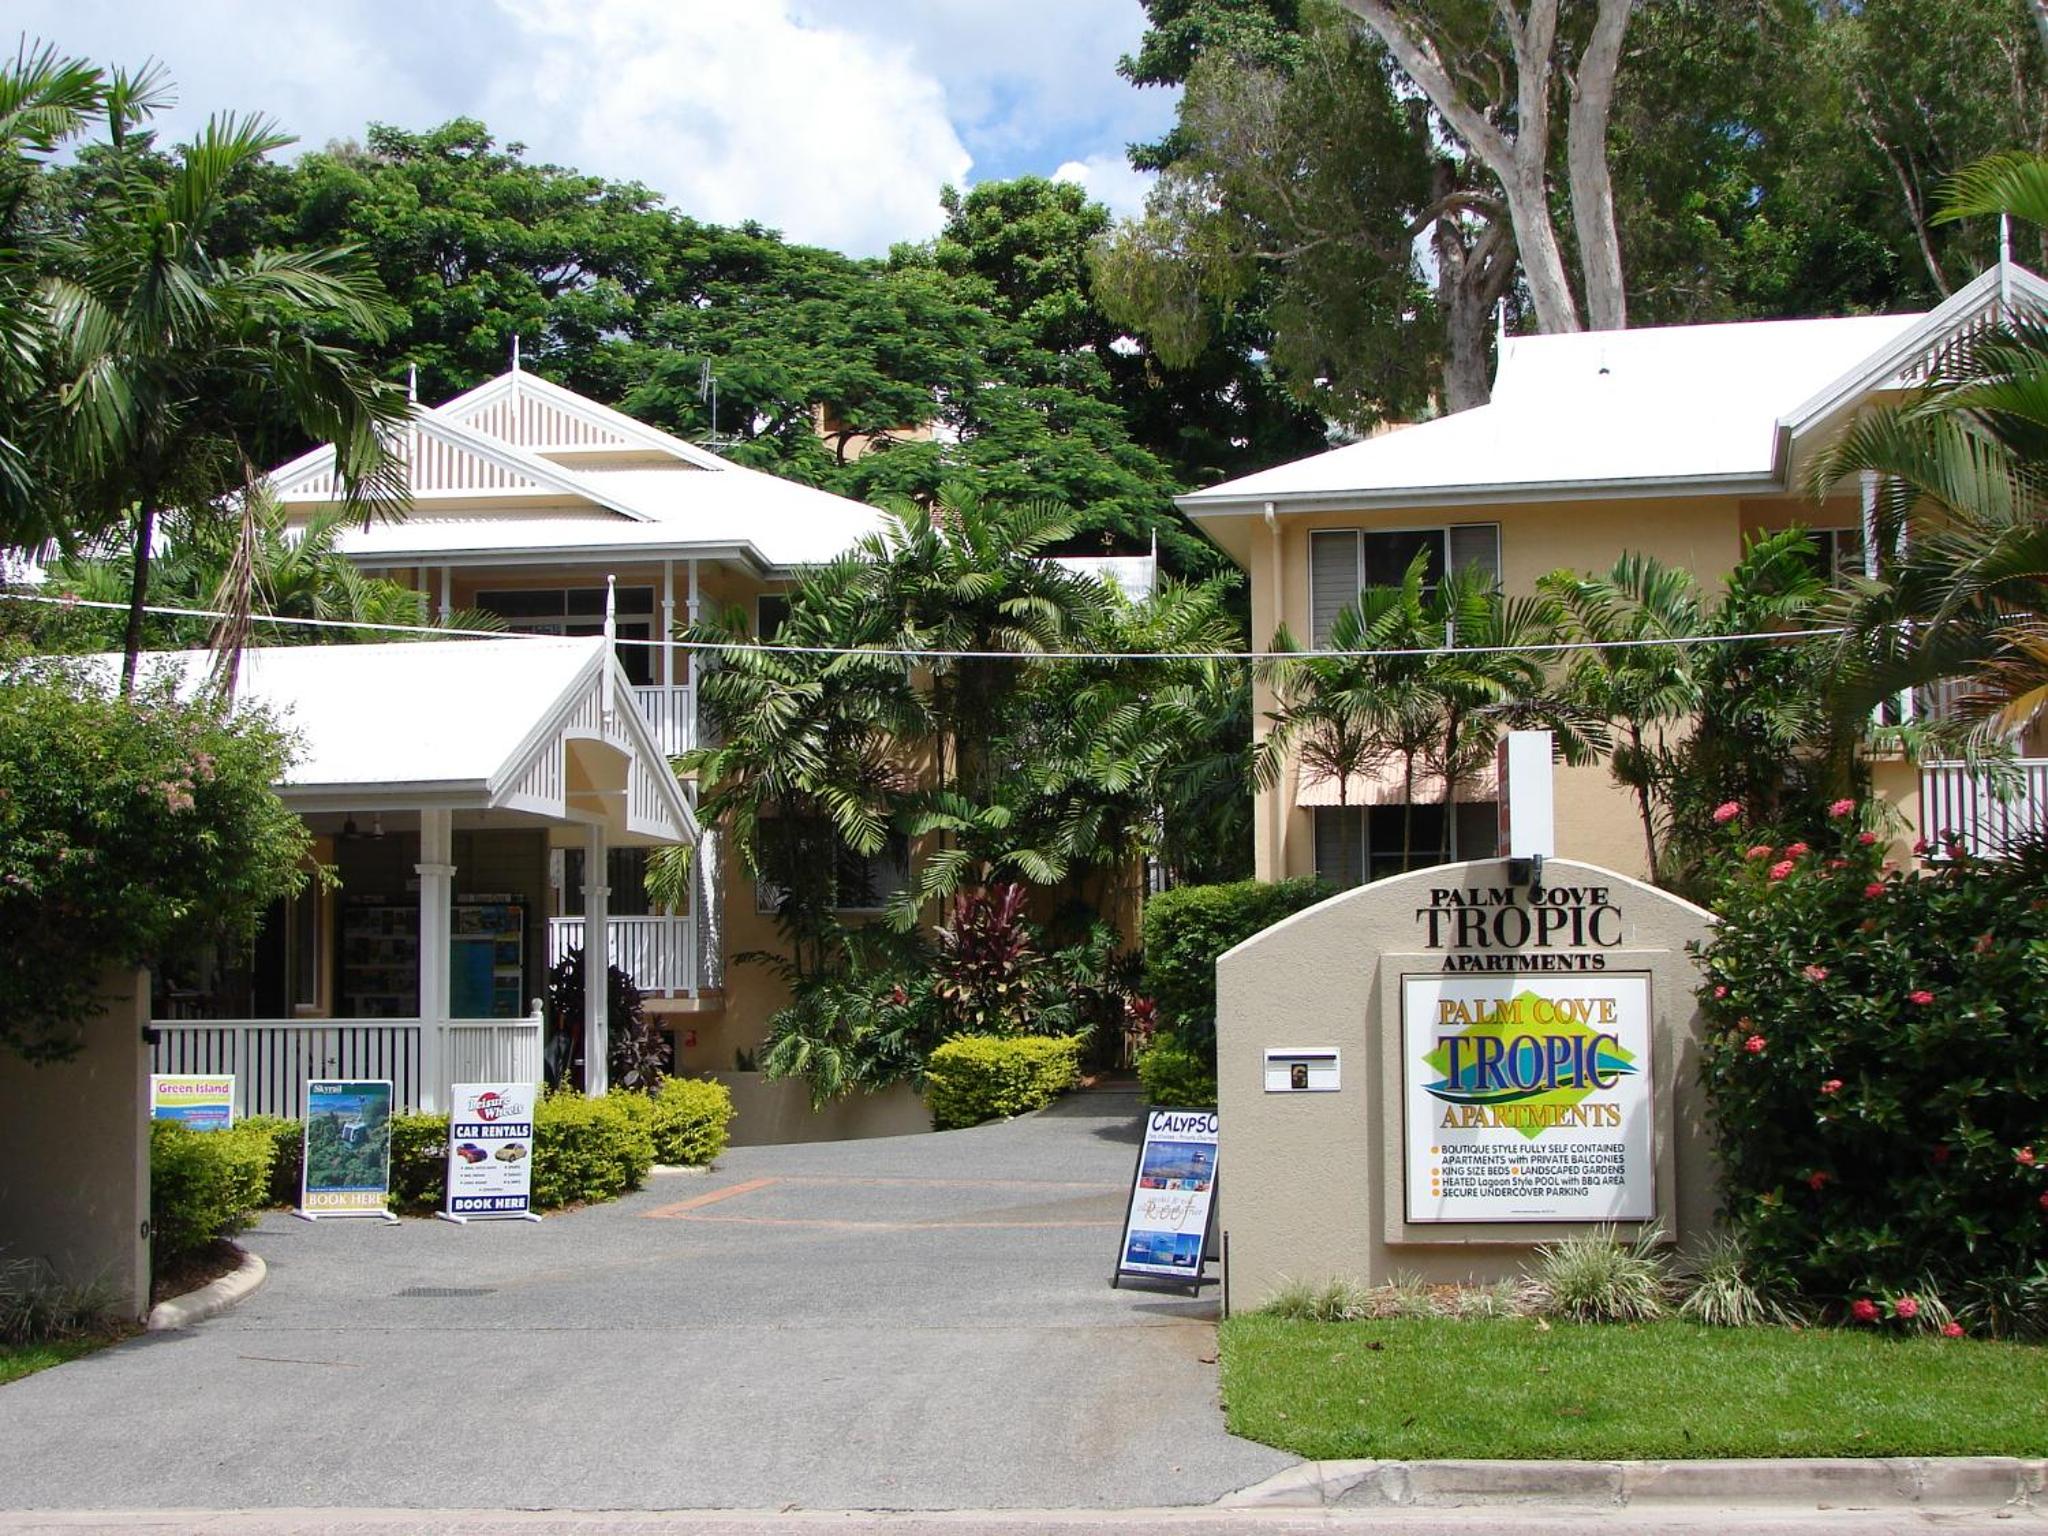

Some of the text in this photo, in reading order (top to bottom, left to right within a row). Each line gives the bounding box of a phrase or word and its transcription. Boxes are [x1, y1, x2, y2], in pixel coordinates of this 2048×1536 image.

[1430, 887, 1609, 907] PALM COVE
[1416, 905, 1622, 949] TROPIC
[1441, 953, 1605, 971] APARTMENTS
[1438, 997, 1618, 1025] PALM COVE
[1438, 1033, 1620, 1092] TROPIC
[159, 1083, 229, 1093] Green Island
[1152, 1111, 1218, 1133] CALYPSO
[1439, 1103, 1621, 1129] APARTMENTS
[456, 1125, 529, 1137] CAR RENTALS
[1441, 1143, 1625, 1154] BOUTIQUE STYLE FULLY SELF CONTAINED
[1441, 1154, 1625, 1165] APARTMENTS with PRIVATE BALCONIES
[1442, 1165, 1625, 1176] KING SIZE BEDS LANDSCAPED GARDENS
[1442, 1176, 1625, 1188] HEATED Lagoon Style POOL with BBQ AREA
[1442, 1187, 1589, 1197] SECURE UNDERCOVER PARKING
[309, 1193, 347, 1205] BOOK
[455, 1198, 526, 1210] BOOK HERE
